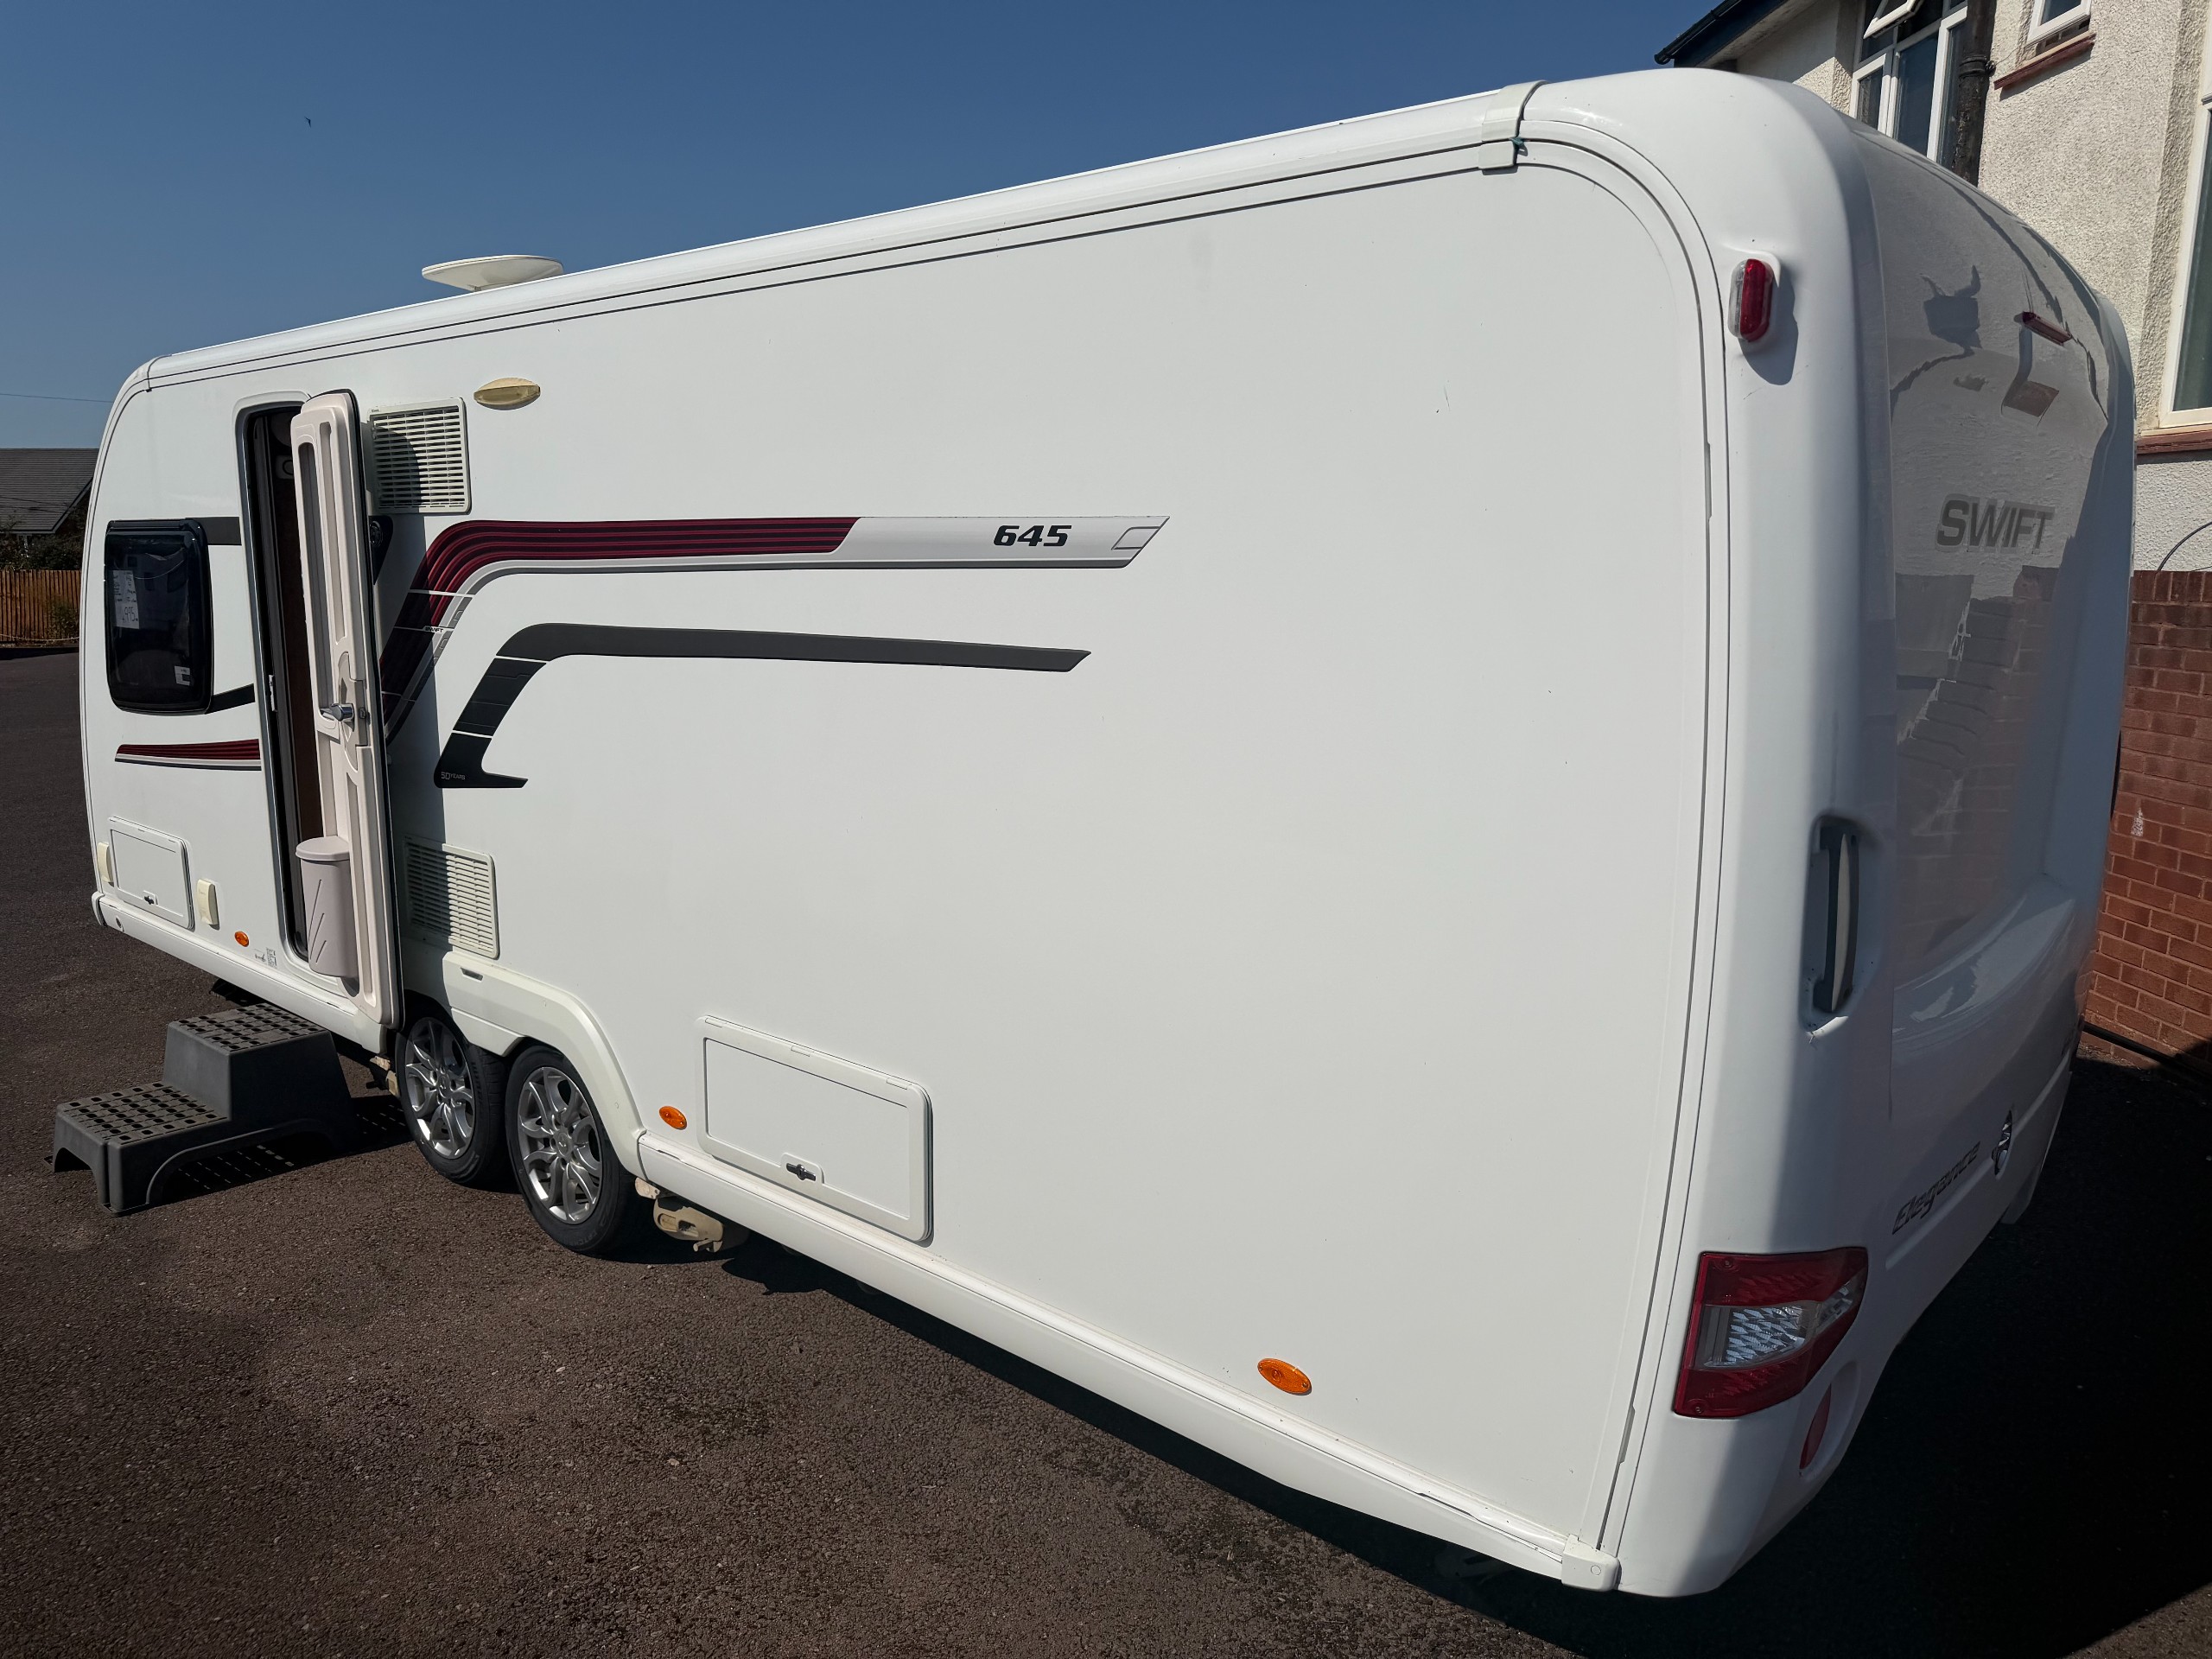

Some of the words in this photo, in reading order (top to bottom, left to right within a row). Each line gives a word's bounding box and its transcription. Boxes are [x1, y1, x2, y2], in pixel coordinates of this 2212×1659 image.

[994, 525, 1072, 546] 645
[1936, 495, 2055, 552] SWIFT
[1891, 1141, 1981, 1236] Elegance
